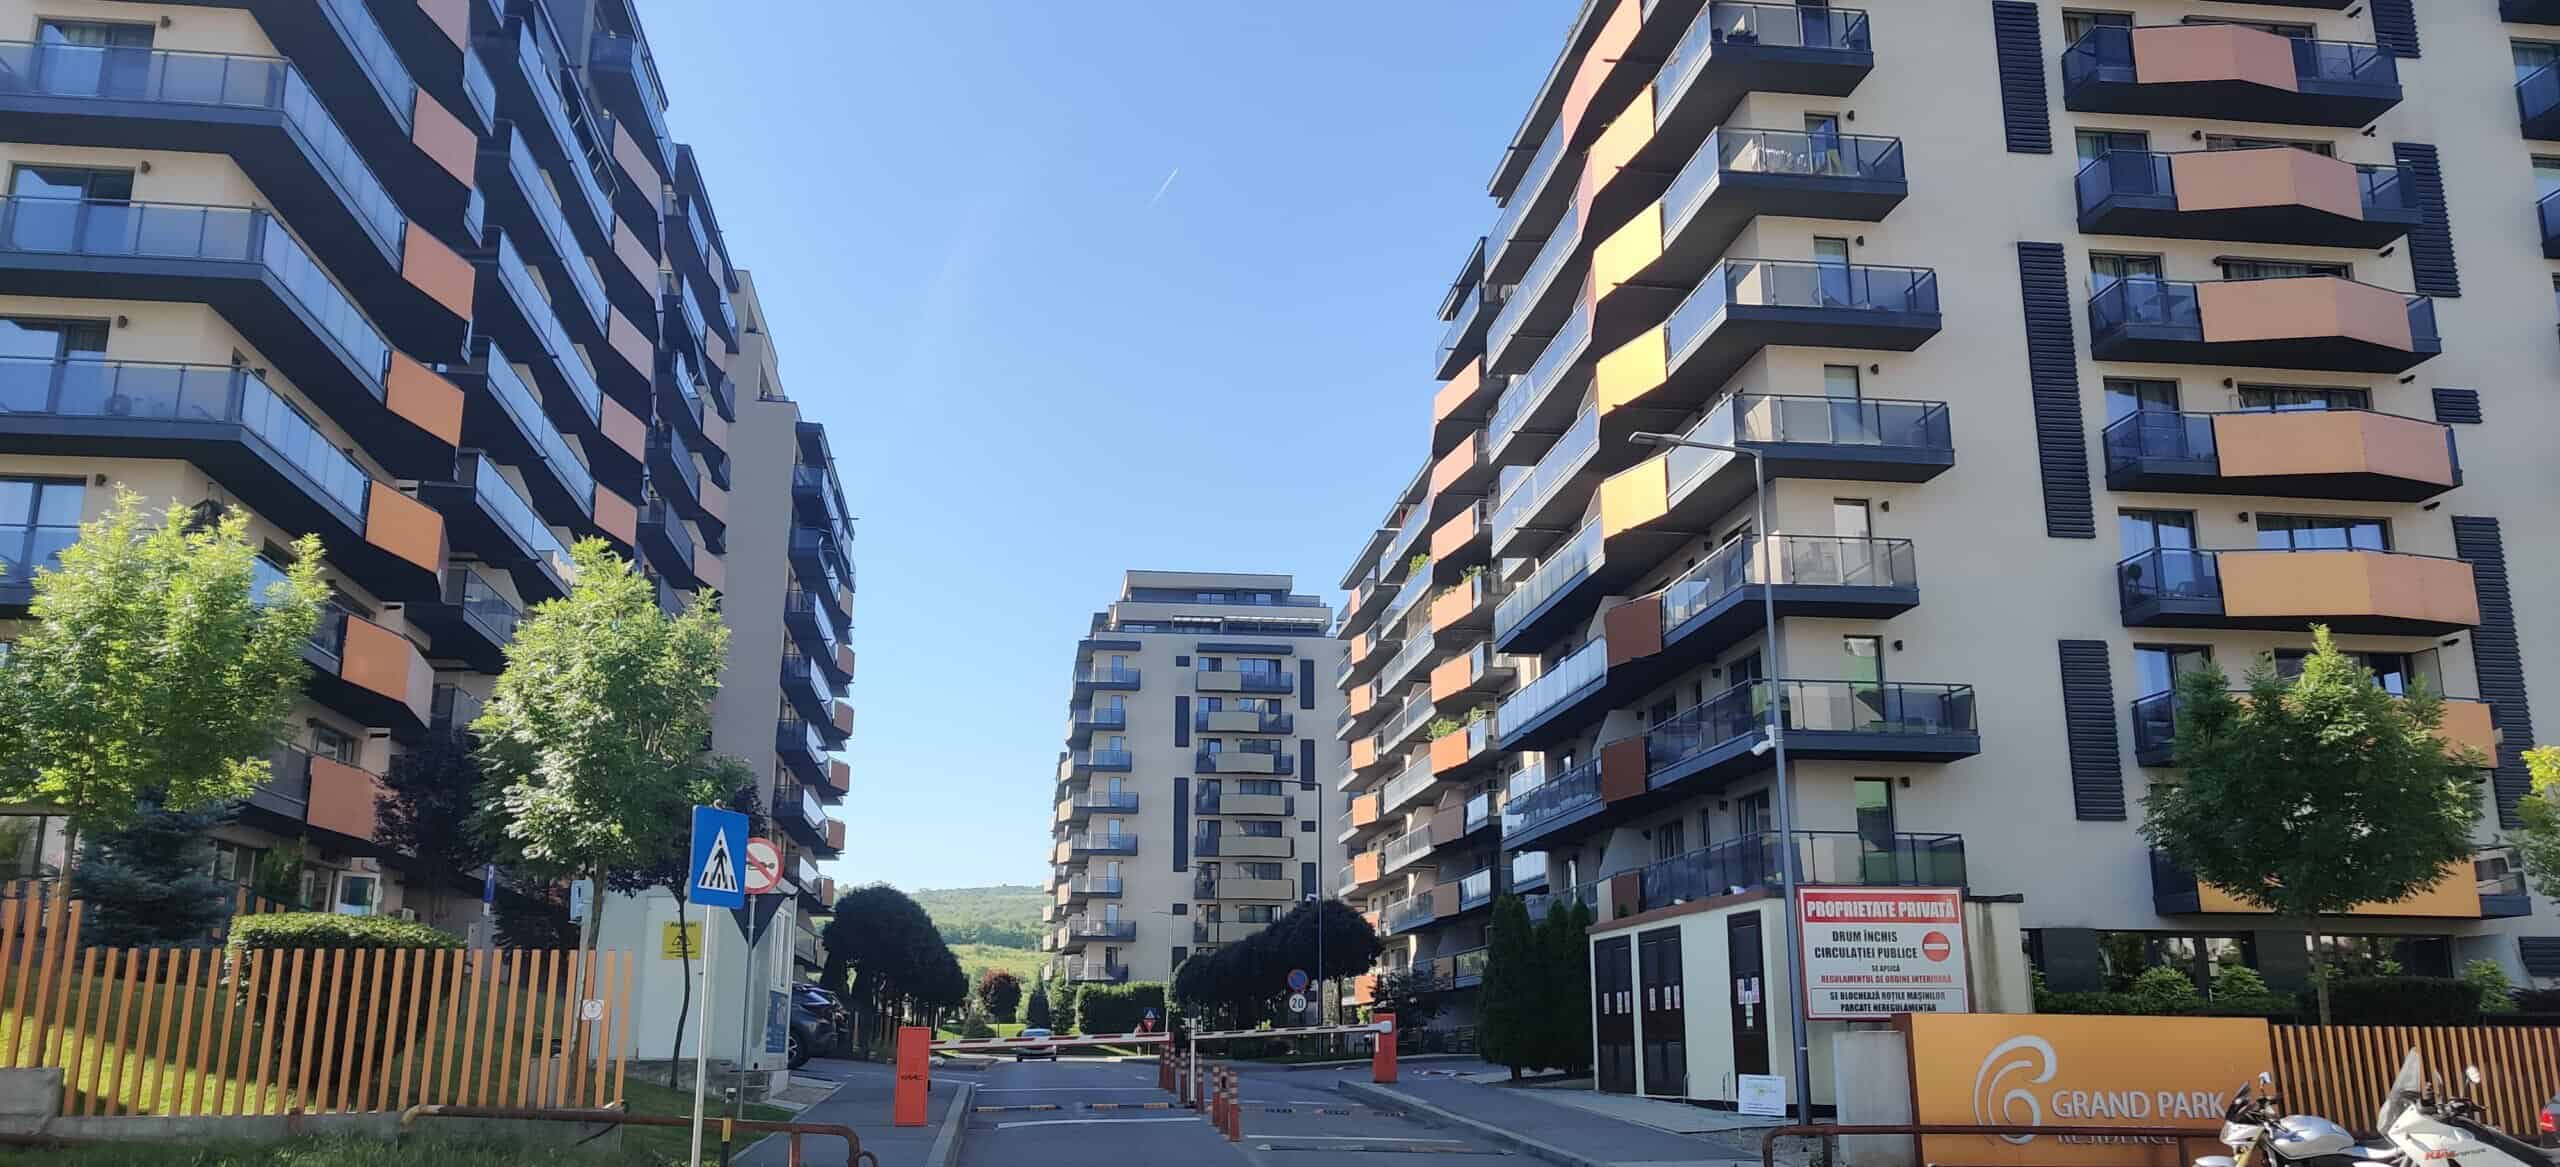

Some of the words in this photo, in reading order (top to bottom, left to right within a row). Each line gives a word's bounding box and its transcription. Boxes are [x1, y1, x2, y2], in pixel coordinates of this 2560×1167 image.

[1807, 900, 1896, 918] PROPRIETATE
[1900, 898, 1955, 918] PRIVATĂ
[1832, 931, 1862, 943] DRUM
[1863, 929, 1898, 943] ÎNCHIS
[1815, 947, 1875, 961] CIRCULAȚIEI
[1878, 947, 1918, 959] PUBLICE
[1821, 976, 1874, 984] REGULAMENTUL
[1875, 976, 1884, 984] DE
[1830, 992, 1838, 1001] SE
[1840, 991, 1880, 1001] BLOCHEAZĂ
[1292, 998, 1304, 1008] 20
[1840, 1004, 1871, 1012] PARCATE
[2052, 1090, 2151, 1119] GRAND
[2157, 1091, 2226, 1119] PARK
